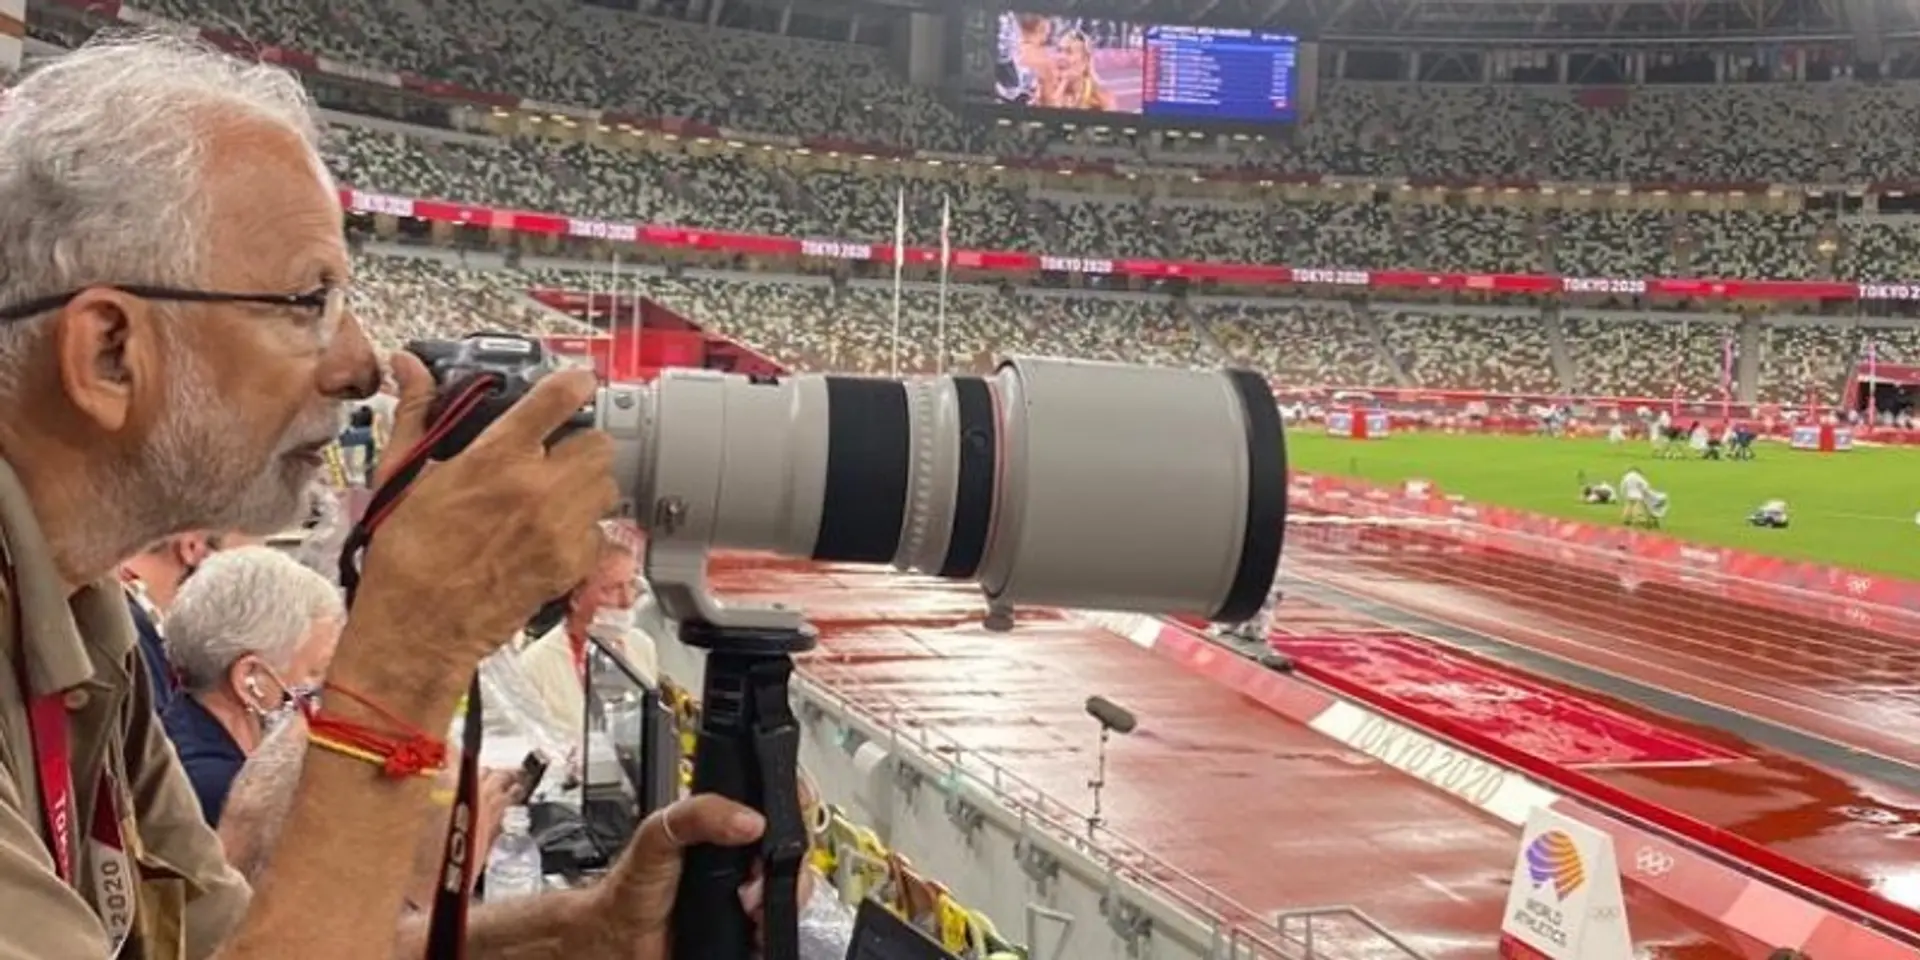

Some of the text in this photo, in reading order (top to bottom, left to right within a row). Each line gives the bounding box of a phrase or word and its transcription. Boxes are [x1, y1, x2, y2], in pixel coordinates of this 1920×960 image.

[801, 240, 870, 259] TOKYO 2020
[1041, 256, 1112, 273] TOKYO 2020
[1292, 268, 1369, 284] TOKYO 2020
[1563, 278, 1646, 293] TOKYO 2020
[1859, 284, 1909, 299] TOKYO
[1350, 706, 1505, 805] TOKYO 2020
[444, 802, 469, 893] EOS
[101, 860, 128, 927] 2020
[1525, 898, 1563, 926] WORLD
[1514, 909, 1567, 948] ATHLETICS
